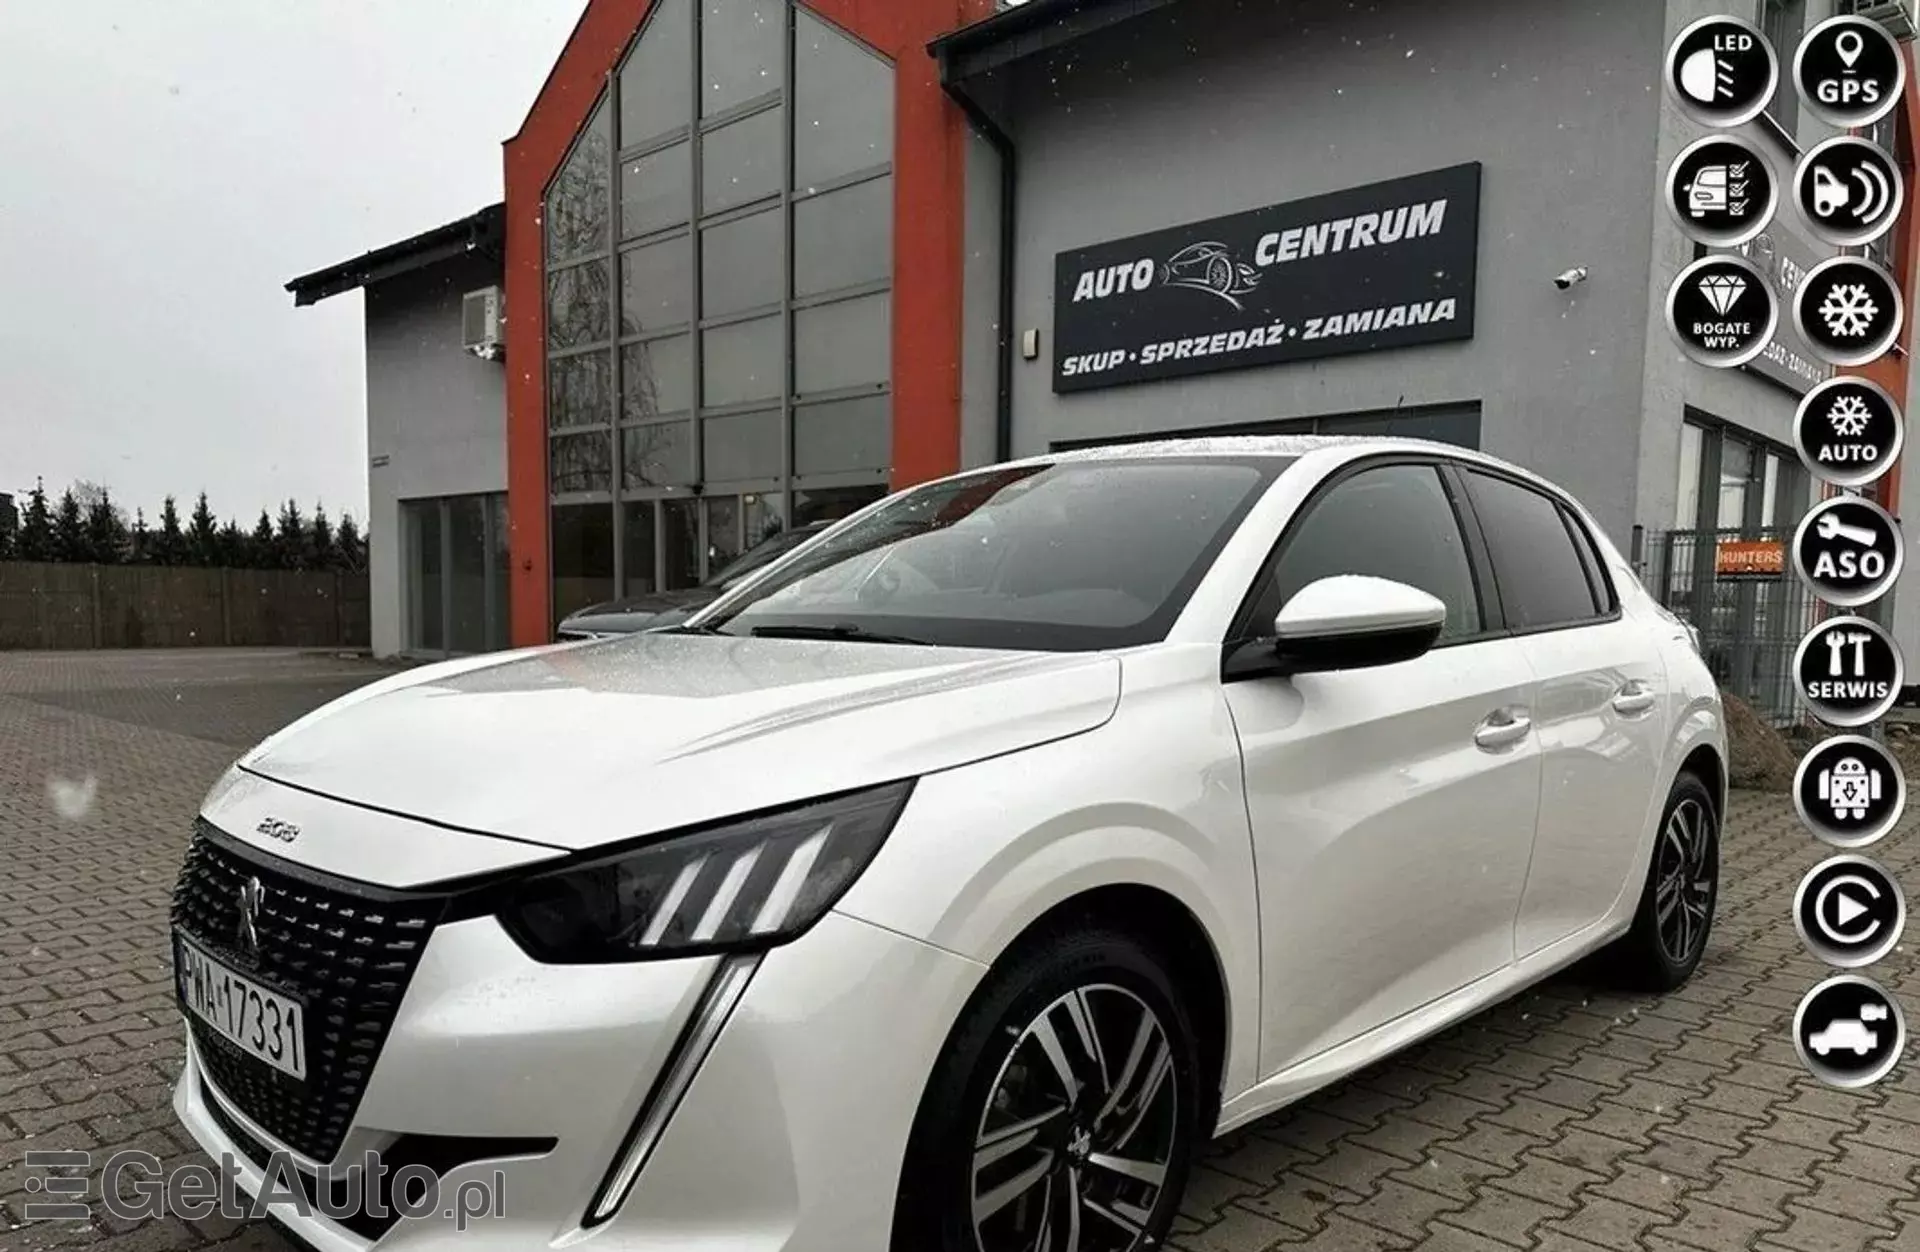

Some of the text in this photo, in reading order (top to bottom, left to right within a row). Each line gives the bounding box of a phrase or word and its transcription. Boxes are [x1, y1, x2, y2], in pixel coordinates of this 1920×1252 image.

[1072, 198, 1448, 303] AUTO CENTRUM
[1062, 349, 1126, 376] SKUP
[1303, 298, 1457, 340] ZAMIANA
[1719, 550, 1783, 564] HUNTERS
[256, 817, 300, 843] 208
